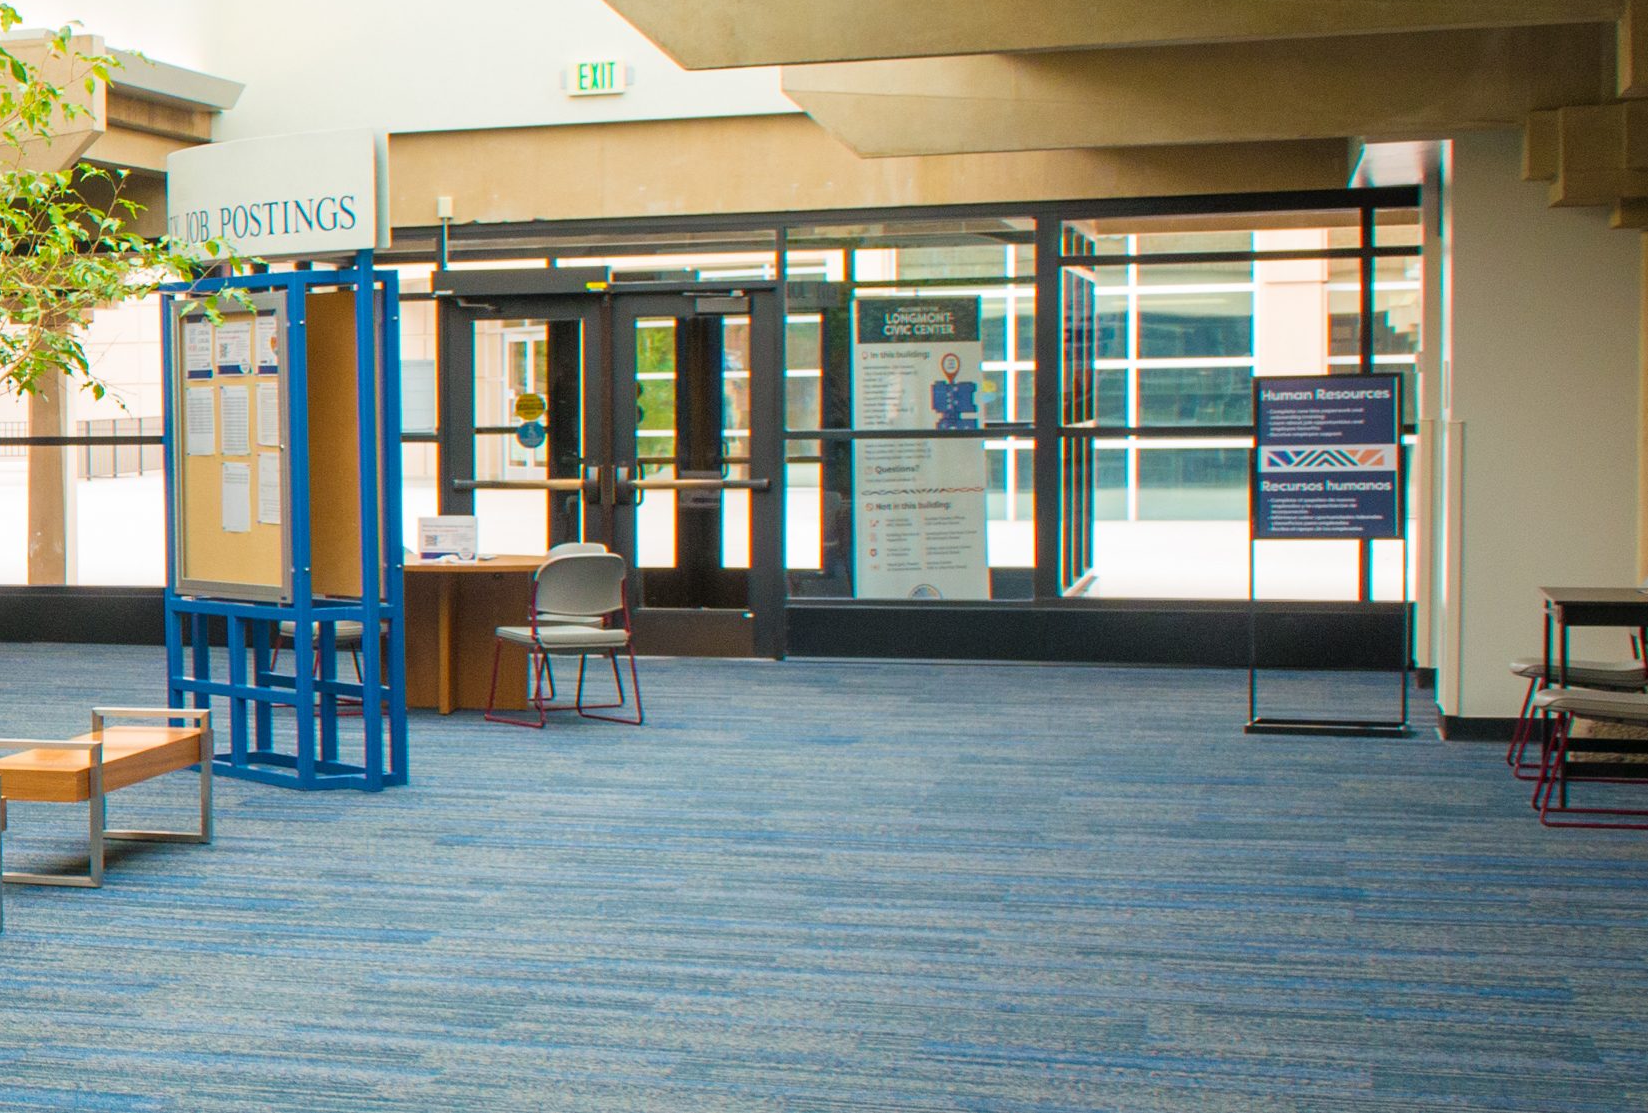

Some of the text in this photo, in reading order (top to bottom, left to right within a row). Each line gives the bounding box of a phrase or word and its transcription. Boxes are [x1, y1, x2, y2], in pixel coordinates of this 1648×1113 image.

[578, 62, 615, 90] EXIT
[185, 210, 209, 244] JOB
[220, 195, 356, 239] POSTINGS
[885, 312, 953, 324] LONGMONT
[883, 324, 955, 336] CIVIC CENTER
[1260, 388, 1391, 401] Human Resources
[875, 464, 920, 474] Questions?
[1260, 480, 1392, 492] Recursos humanos
